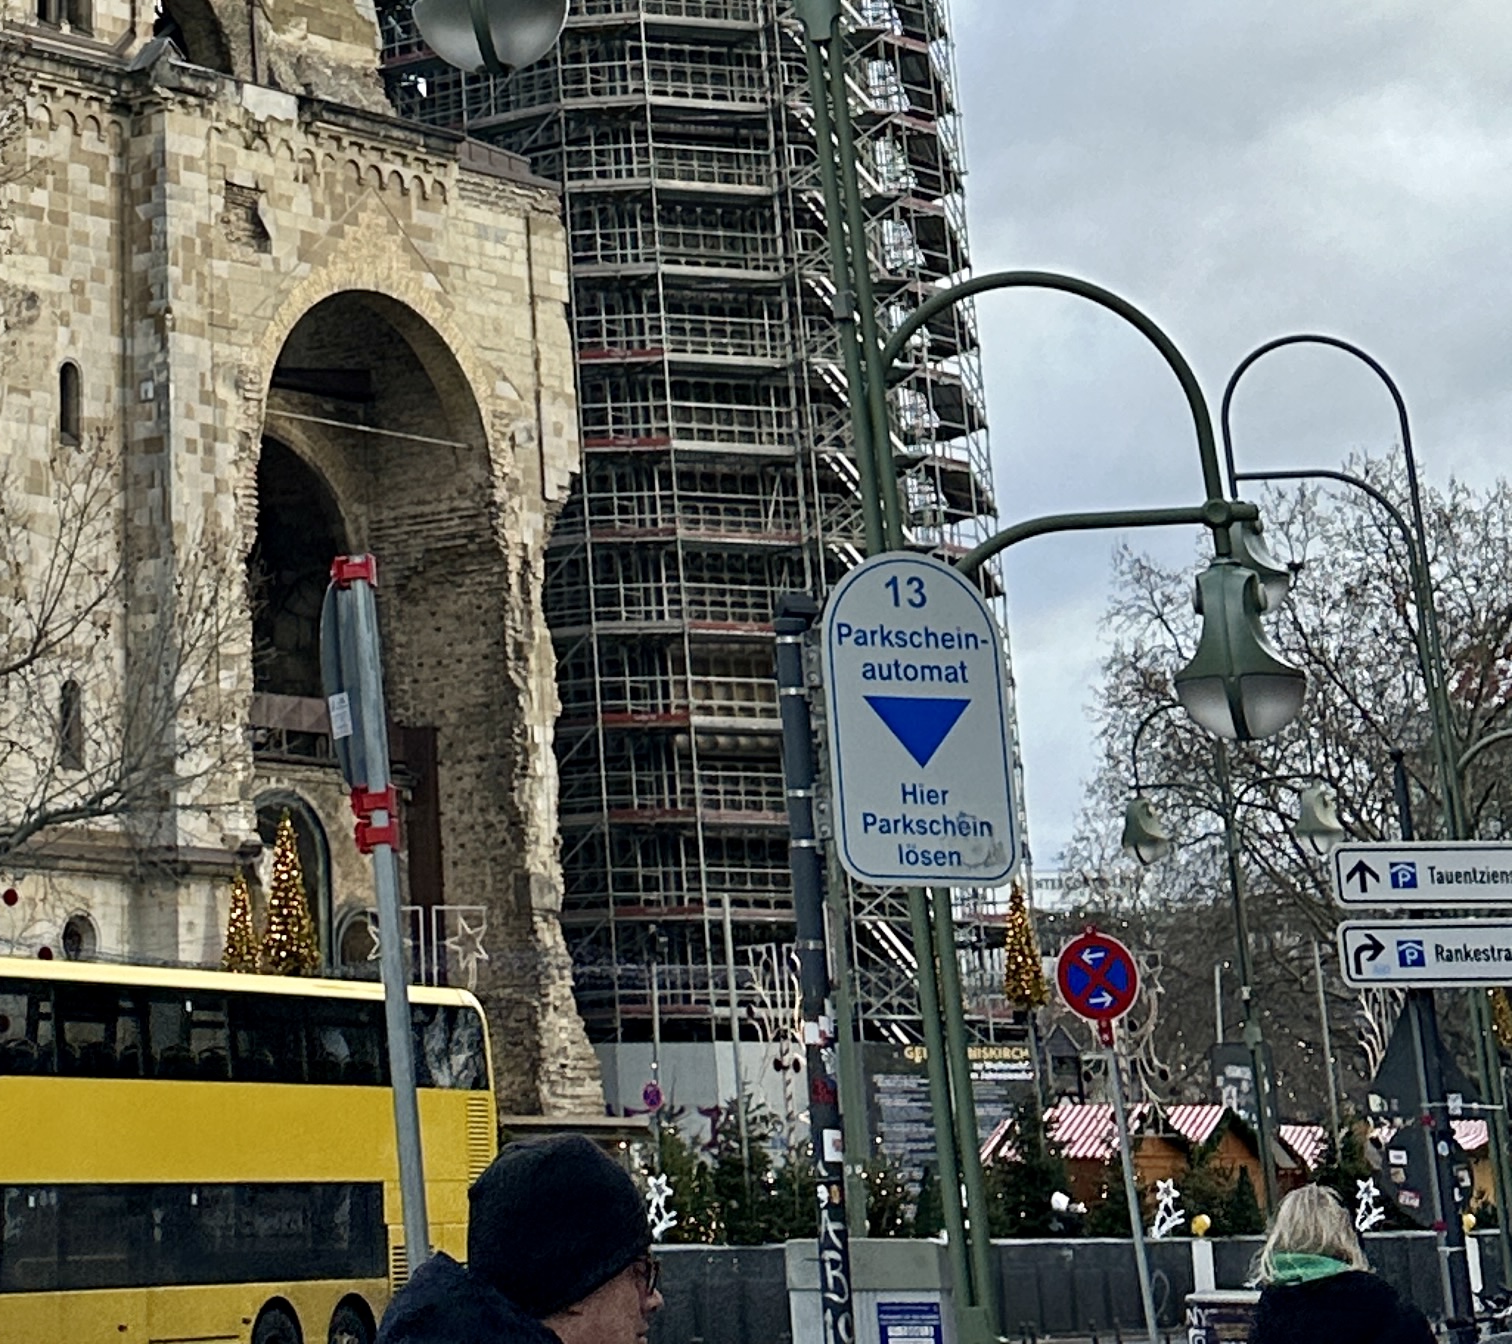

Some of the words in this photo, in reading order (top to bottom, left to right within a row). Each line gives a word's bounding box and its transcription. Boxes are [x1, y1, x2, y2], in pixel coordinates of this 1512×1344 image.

[884, 575, 928, 609] 13
[836, 622, 989, 650] Parkschein-
[861, 659, 969, 684] automat
[901, 782, 950, 806] Hier
[862, 812, 994, 838] Parkschein
[898, 843, 963, 867] lösen
